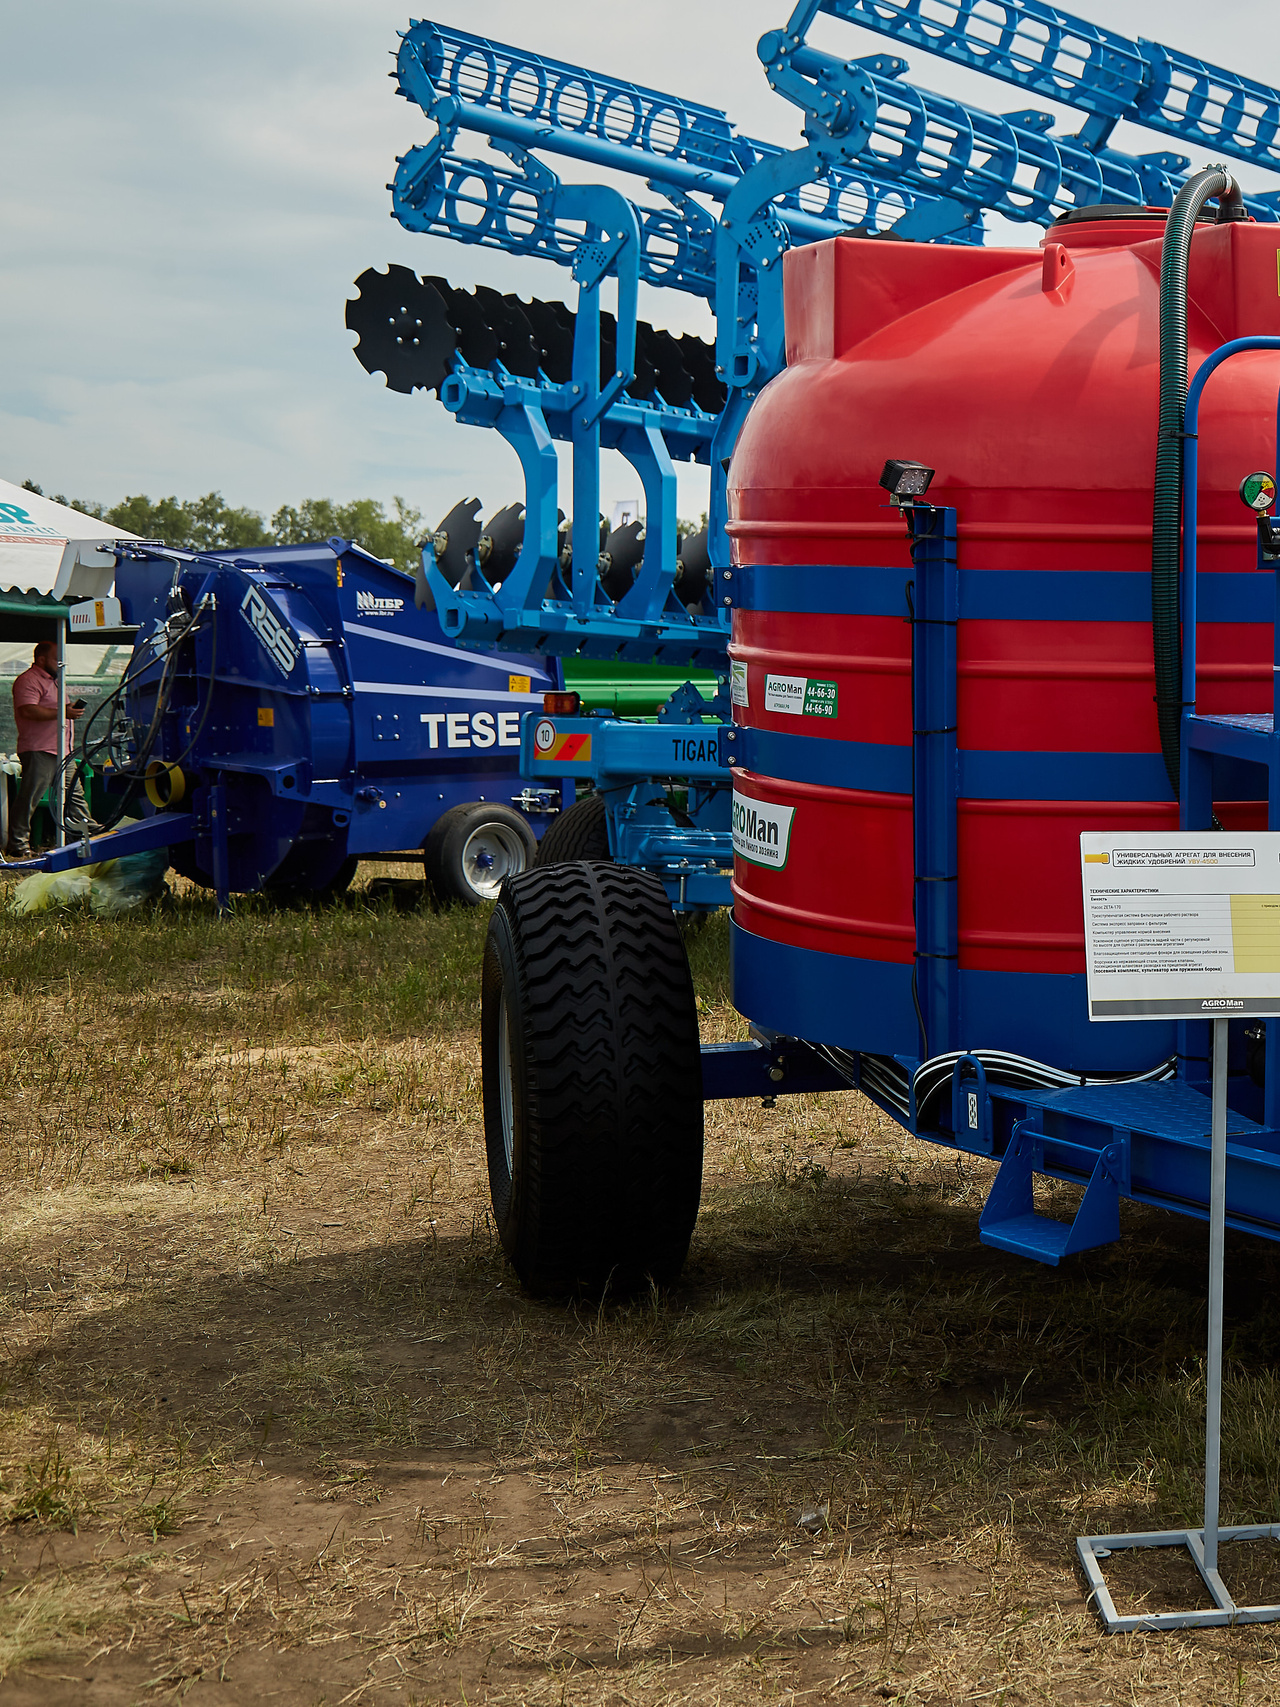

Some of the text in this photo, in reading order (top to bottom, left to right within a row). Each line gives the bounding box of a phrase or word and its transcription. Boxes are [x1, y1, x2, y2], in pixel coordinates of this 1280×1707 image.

[374, 598, 404, 609] ЛБР
[807, 686, 836, 699] 44-66-30
[541, 730, 550, 742] 10
[672, 739, 717, 762] TIGAR
